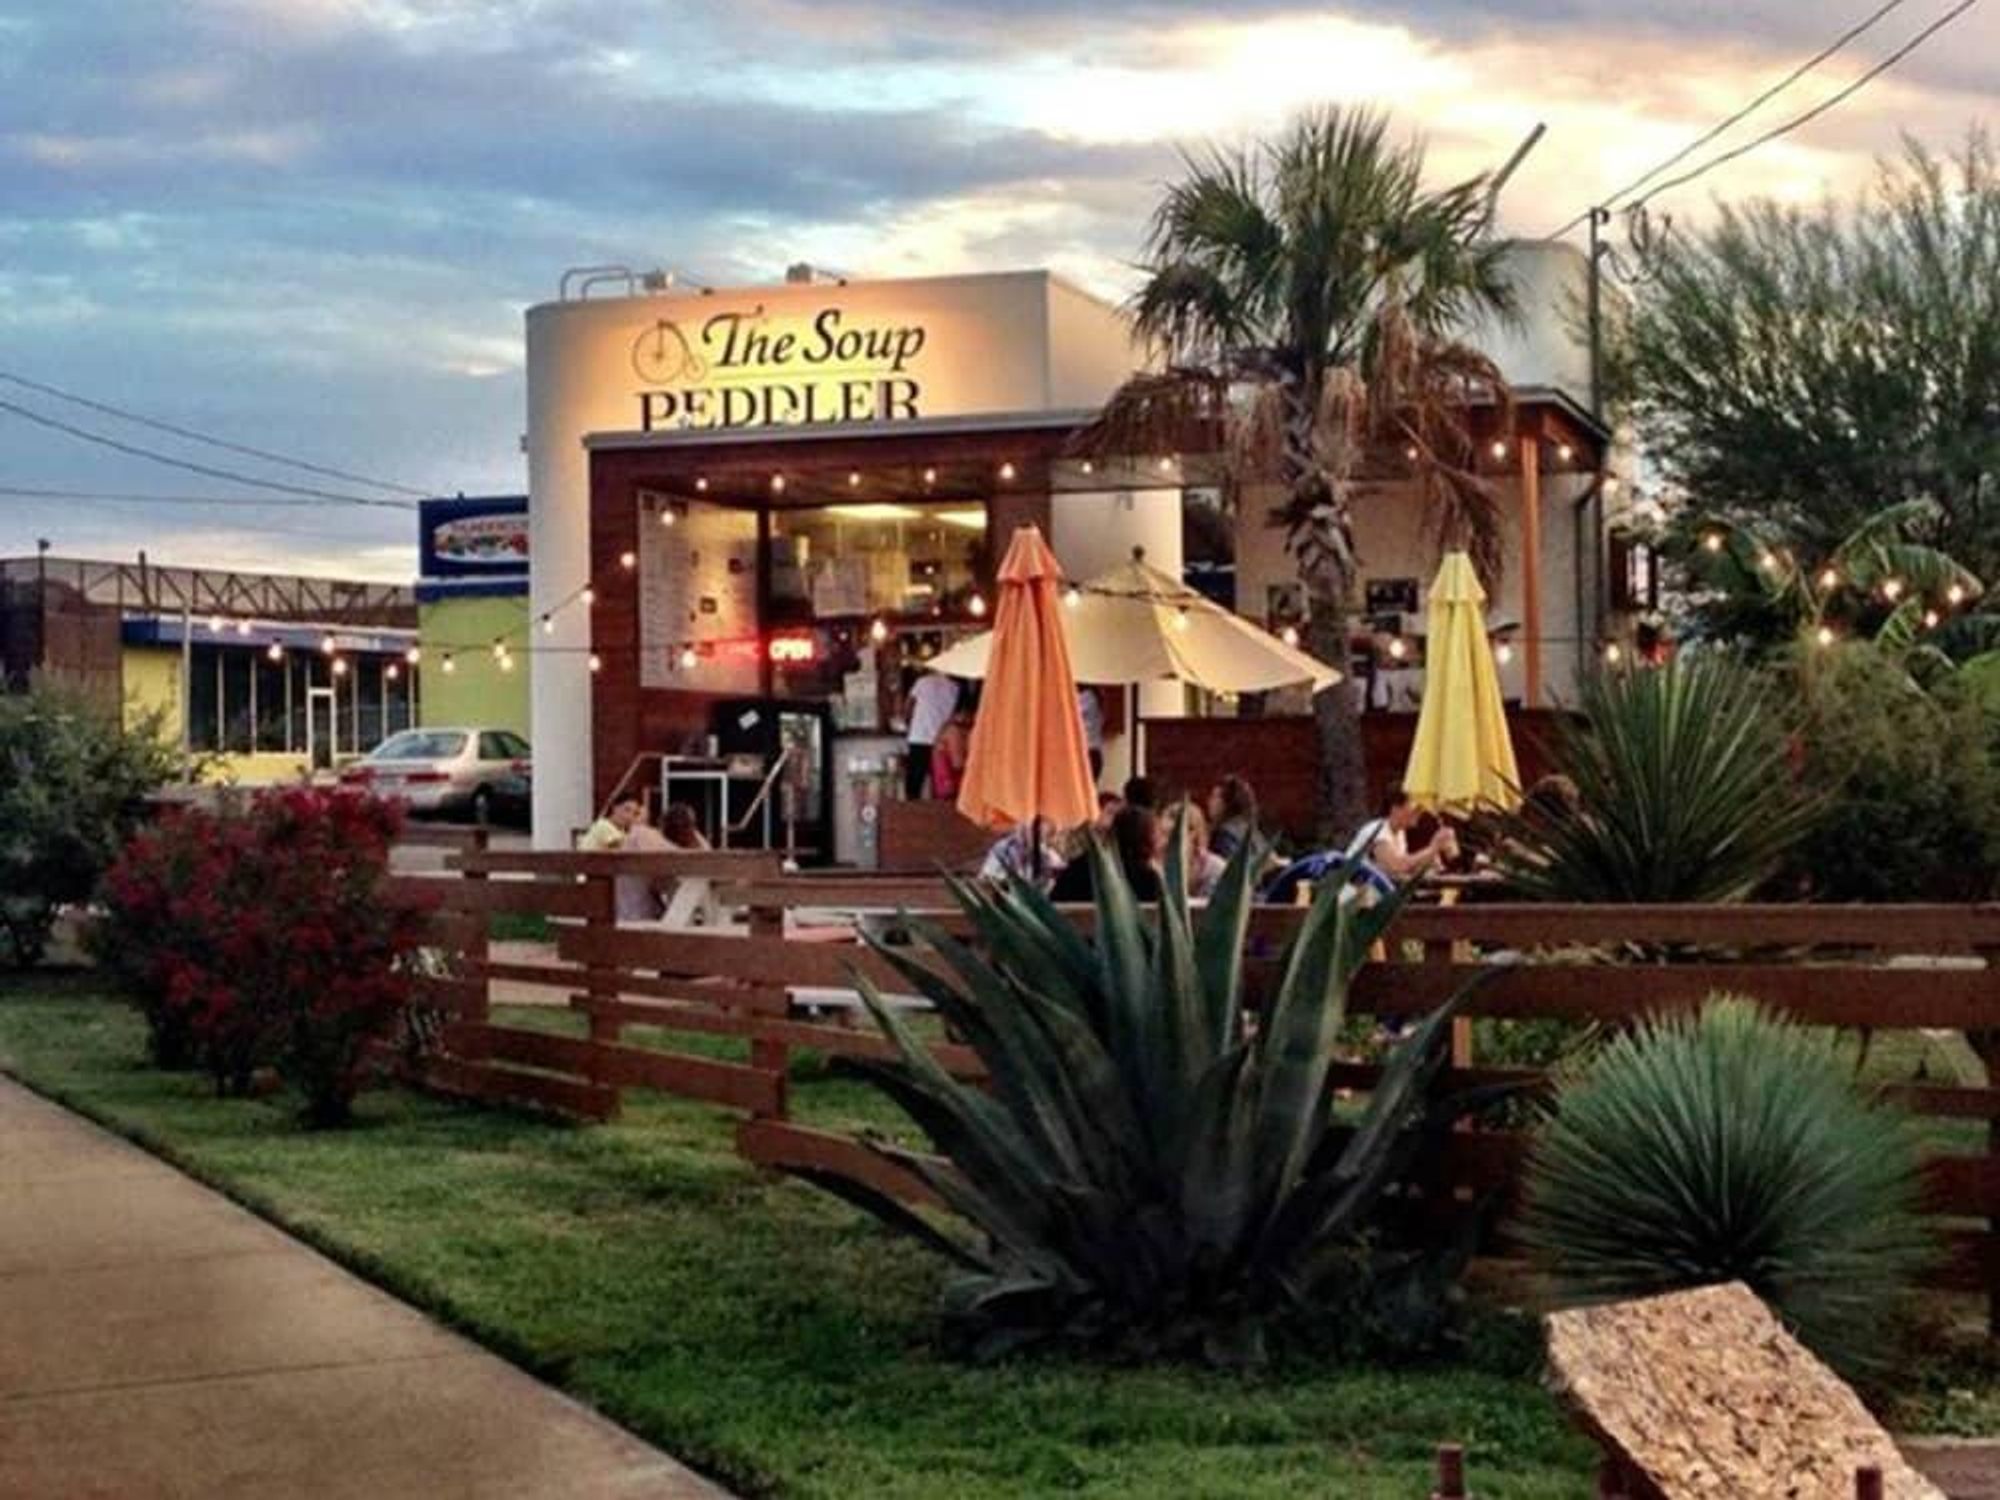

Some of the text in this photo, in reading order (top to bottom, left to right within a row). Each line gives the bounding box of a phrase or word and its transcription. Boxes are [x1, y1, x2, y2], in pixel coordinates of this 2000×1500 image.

[702, 304, 925, 372] The Soup
[637, 379, 921, 432] PEDDLER
